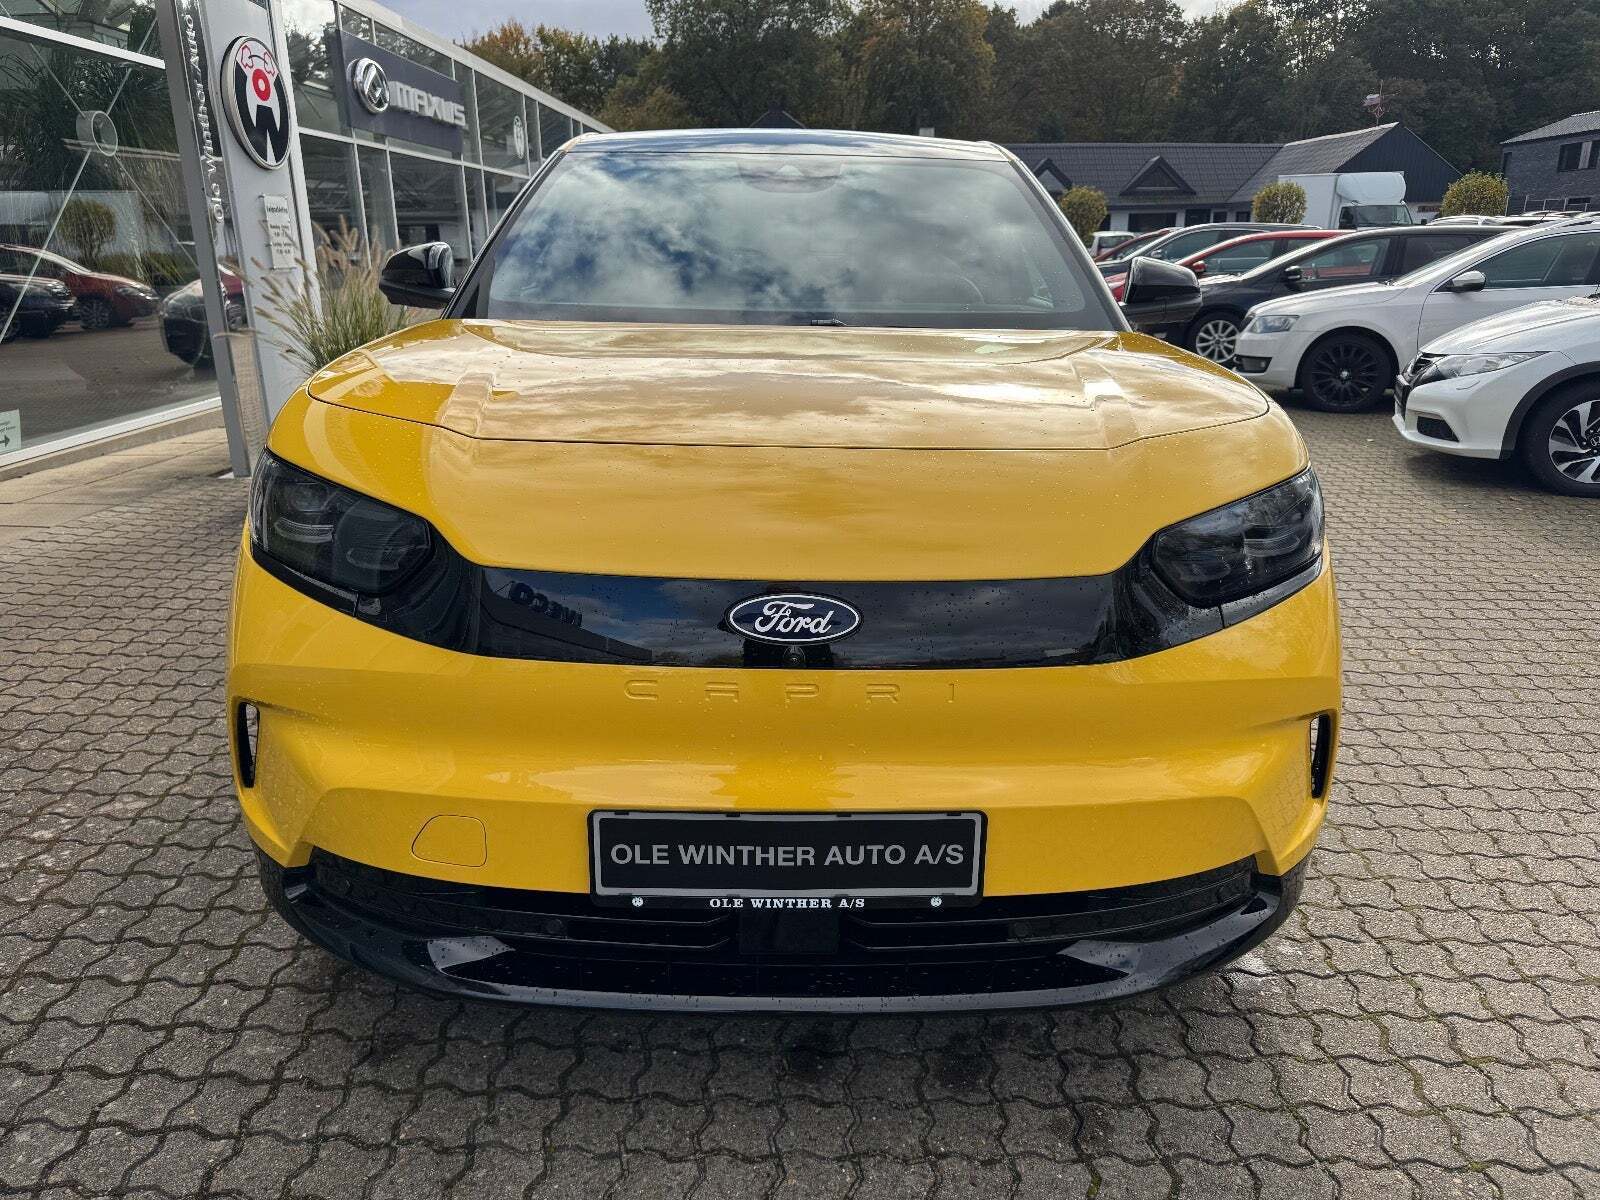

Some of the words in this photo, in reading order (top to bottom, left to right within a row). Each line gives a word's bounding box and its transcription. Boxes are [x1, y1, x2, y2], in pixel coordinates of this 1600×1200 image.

[186, 14, 202, 75] Auto
[388, 81, 466, 127] MAXUS
[196, 82, 217, 178] Winther
[211, 182, 225, 222] Ole
[754, 600, 834, 634] Ford
[623, 678, 960, 704] CAPRI
[610, 843, 670, 866] OLE
[678, 844, 816, 867] WINTHER
[824, 844, 906, 866] AUTO
[914, 844, 965, 866] A/S
[709, 898, 744, 909] OLE
[750, 898, 833, 909] WINTHER
[839, 898, 866, 910] A/S
